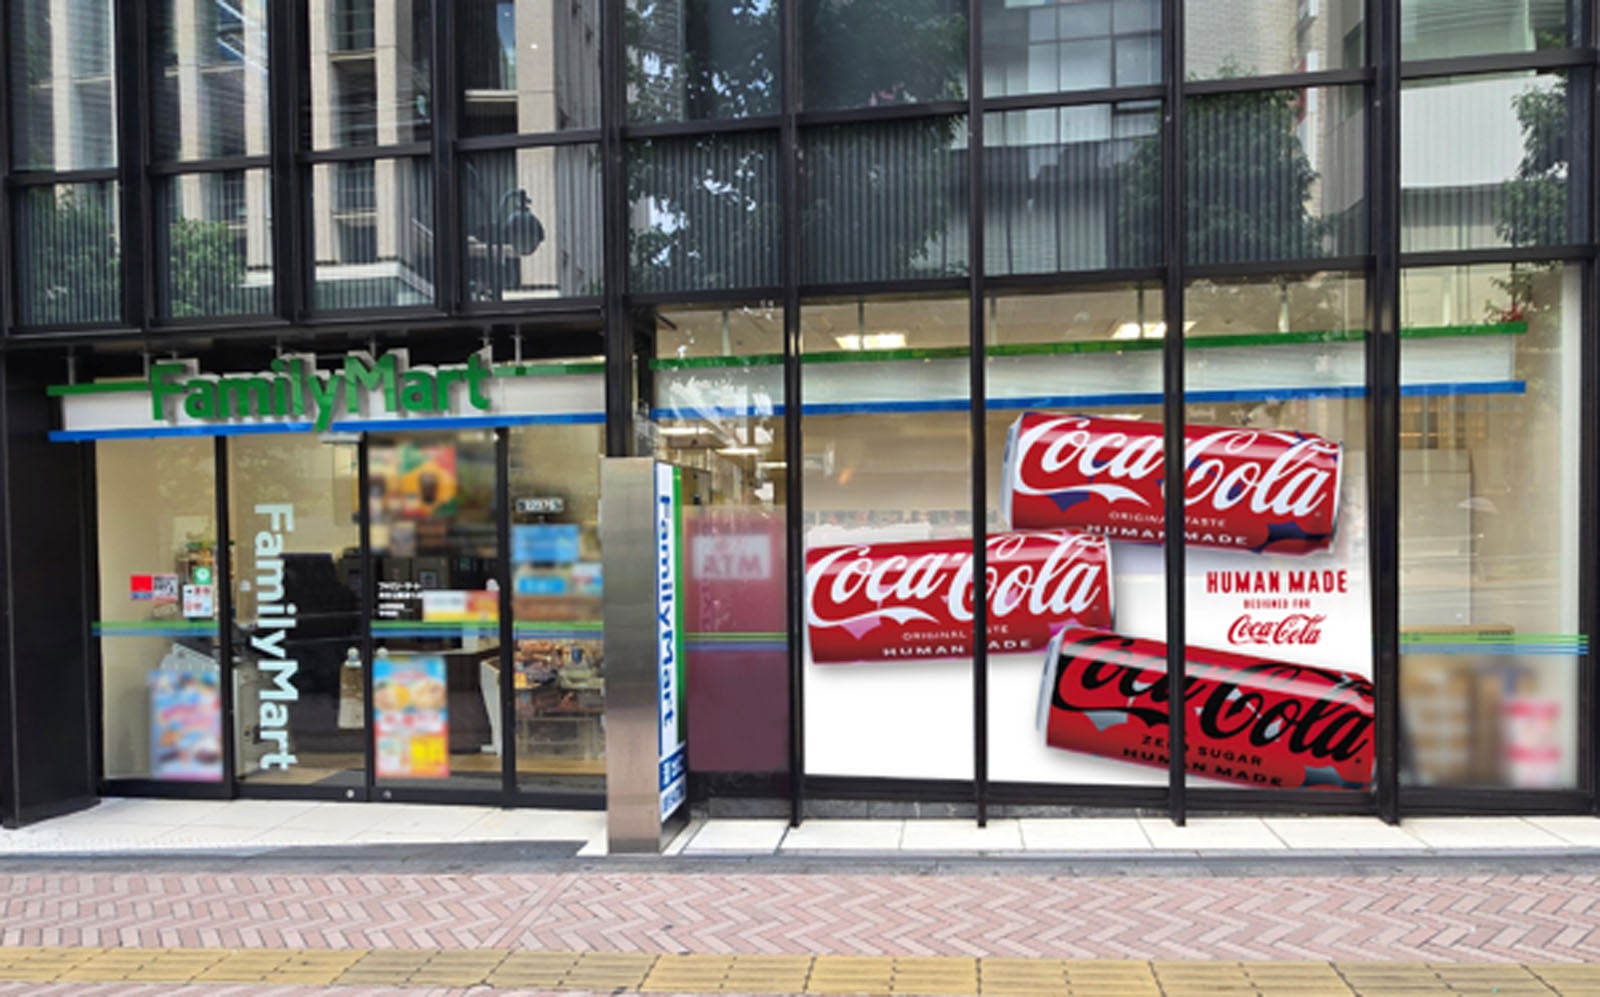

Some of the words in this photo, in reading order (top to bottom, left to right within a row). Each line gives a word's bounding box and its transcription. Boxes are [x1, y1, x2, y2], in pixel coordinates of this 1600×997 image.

[151, 352, 492, 432] FamilyMart
[1109, 510, 1166, 525] ORIGINA
[702, 553, 763, 577] ATM
[1206, 570, 1280, 594] HUMAN
[1287, 570, 1348, 594] MADE
[658, 494, 674, 727] FamilyMart
[251, 503, 300, 771] FamilyMart
[883, 645, 965, 657] HUMAN
[986, 638, 1032, 649] ADE
[903, 630, 967, 641] ORIGINAL
[1123, 747, 1207, 773] HUMN
[1215, 765, 1283, 786] MADE
[1197, 745, 1263, 766] SUGAR
